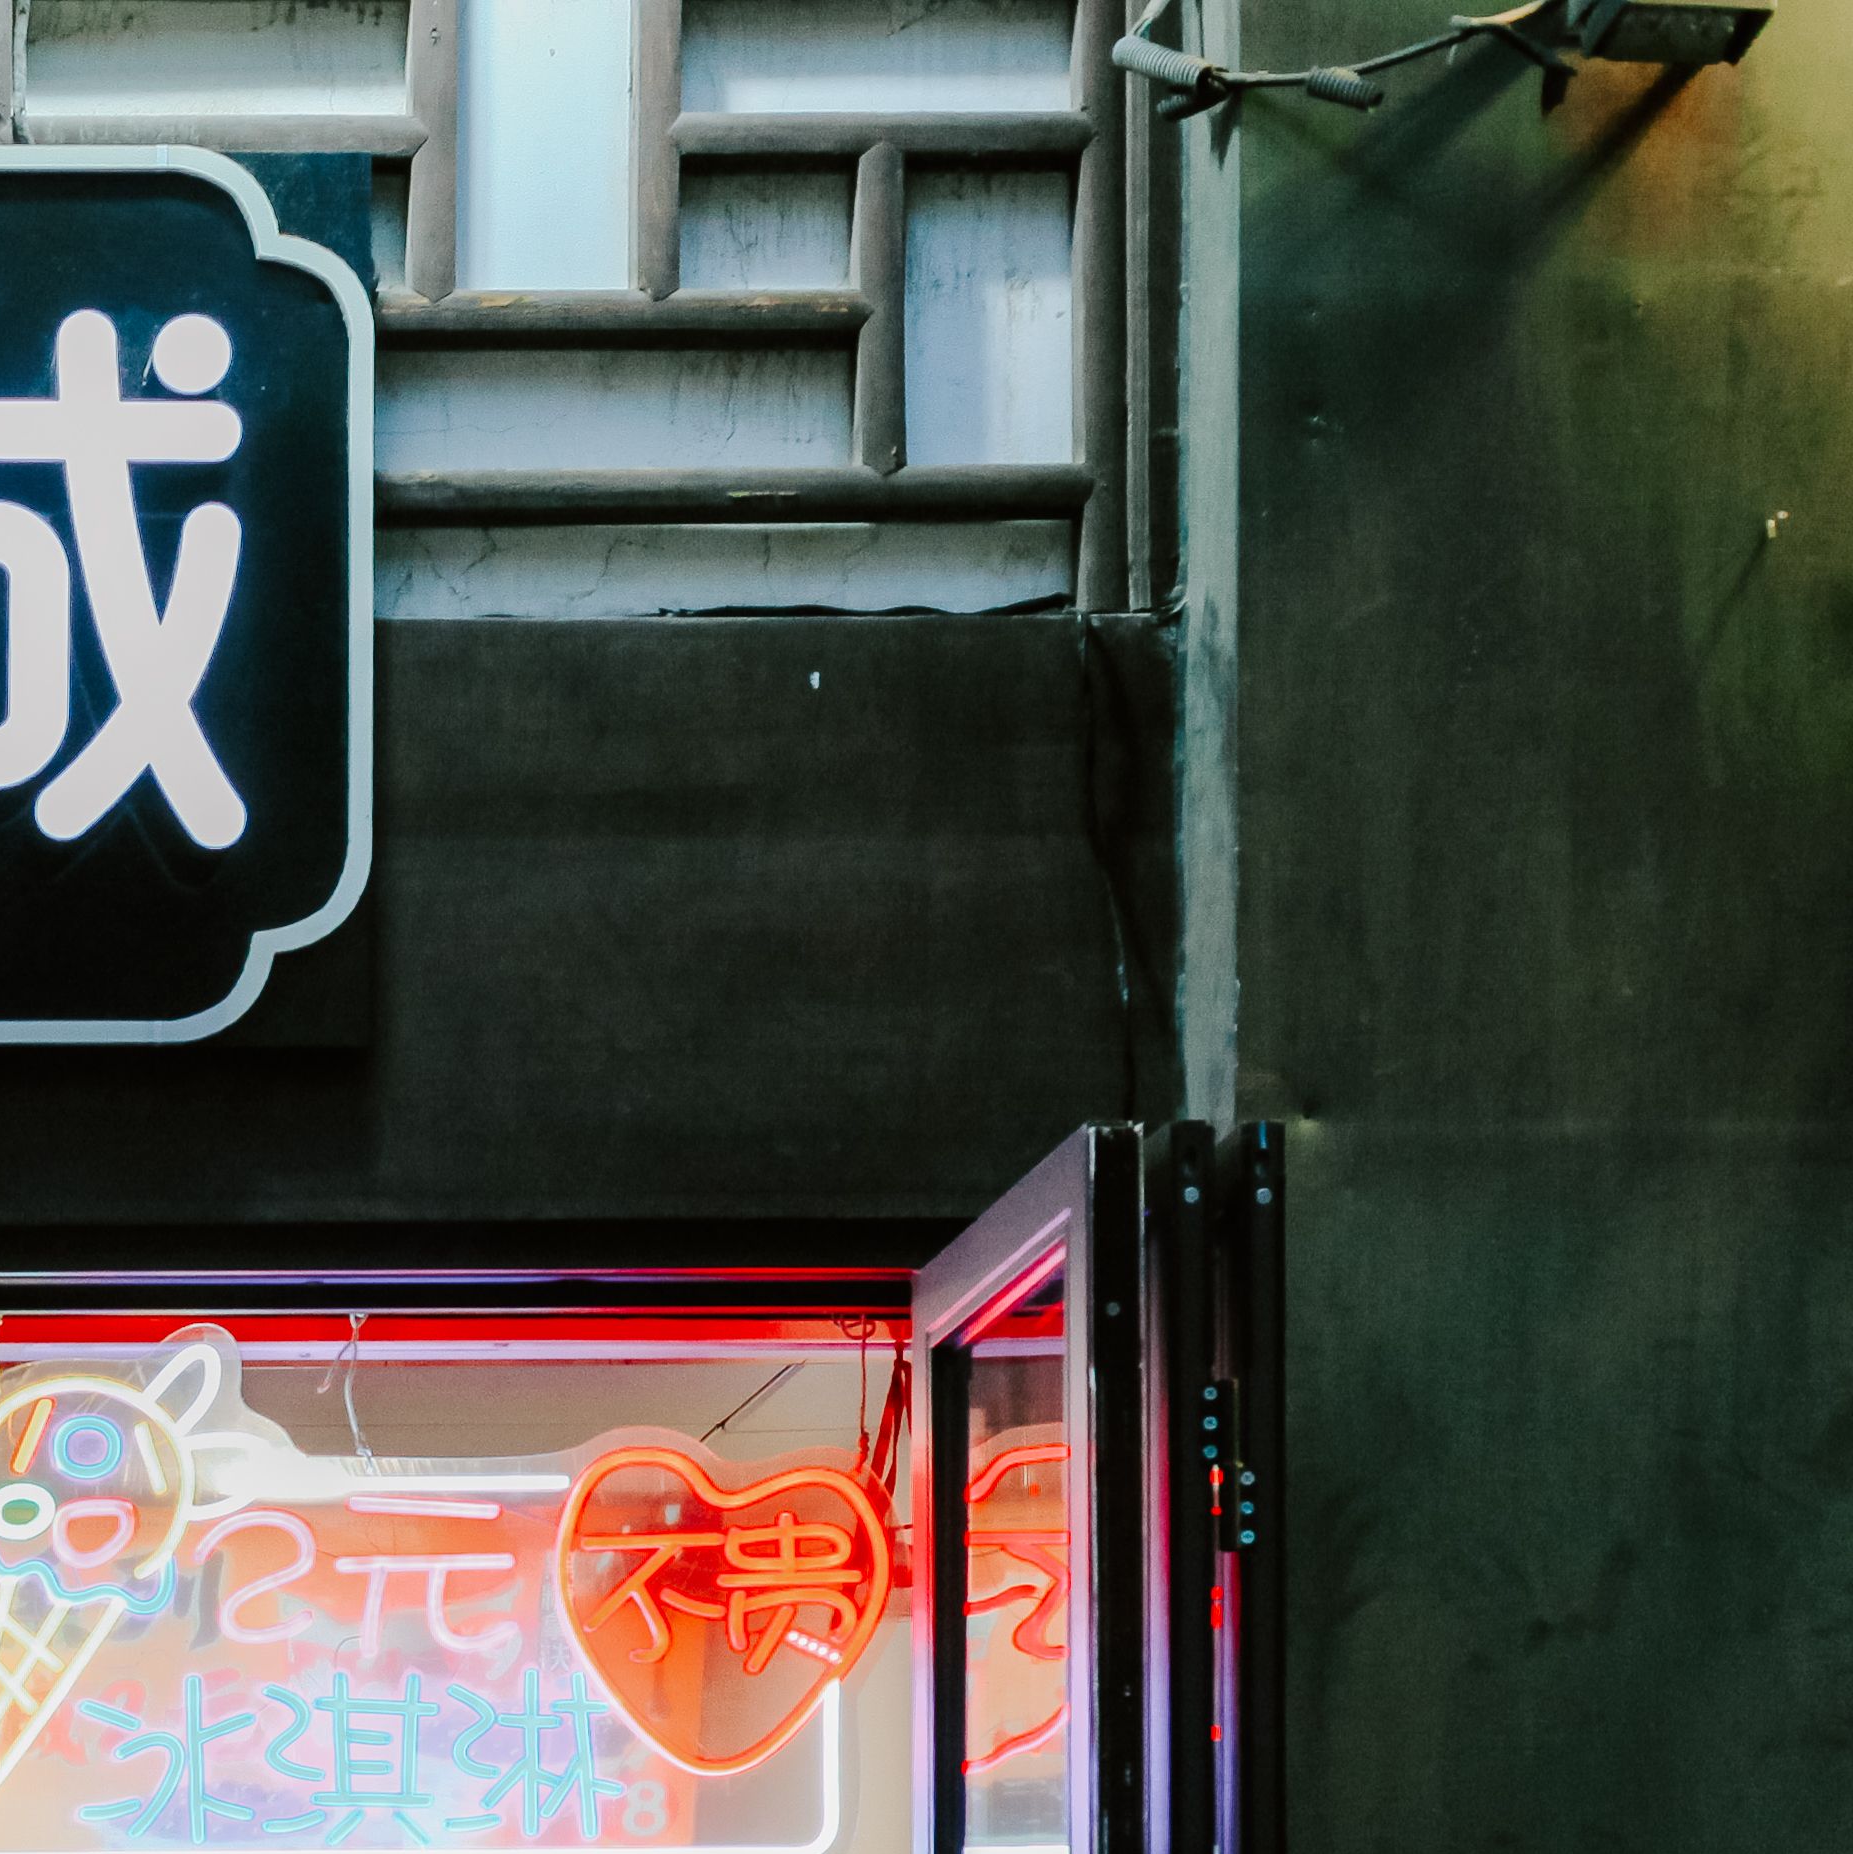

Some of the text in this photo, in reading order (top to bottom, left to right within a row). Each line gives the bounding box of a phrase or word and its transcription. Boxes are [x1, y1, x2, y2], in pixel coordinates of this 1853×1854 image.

[196, 1498, 515, 1654] 2元
[581, 1511, 863, 1675] 不贵
[81, 1669, 626, 1846] 冰淇淋
